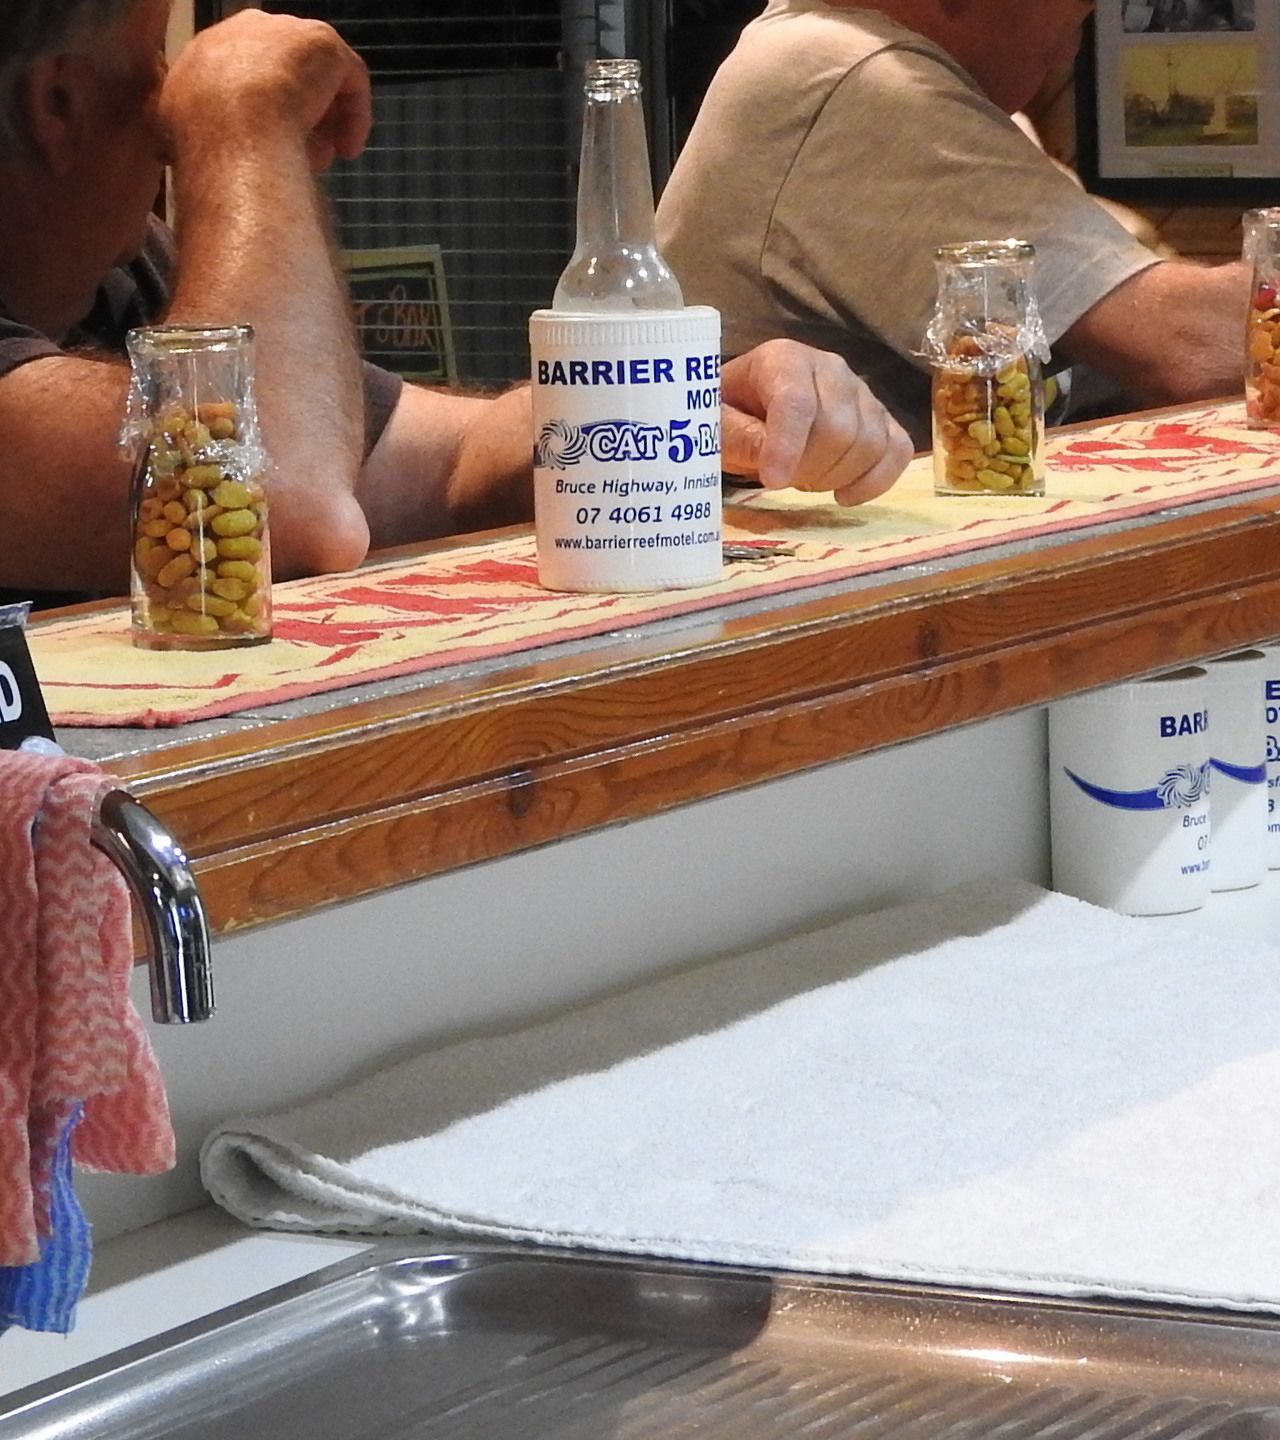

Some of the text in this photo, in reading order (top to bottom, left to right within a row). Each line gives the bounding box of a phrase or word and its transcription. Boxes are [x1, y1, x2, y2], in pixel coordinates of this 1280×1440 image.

[538, 354, 721, 386] BARRIER REE
[686, 387, 721, 411] MOT
[588, 418, 721, 464] CAT 5 BA
[555, 480, 597, 495] Bruce
[602, 478, 678, 498] Highway,
[575, 501, 712, 525] 07 4061 4988
[554, 530, 721, 550] www.barrierreefmotel.com.a
